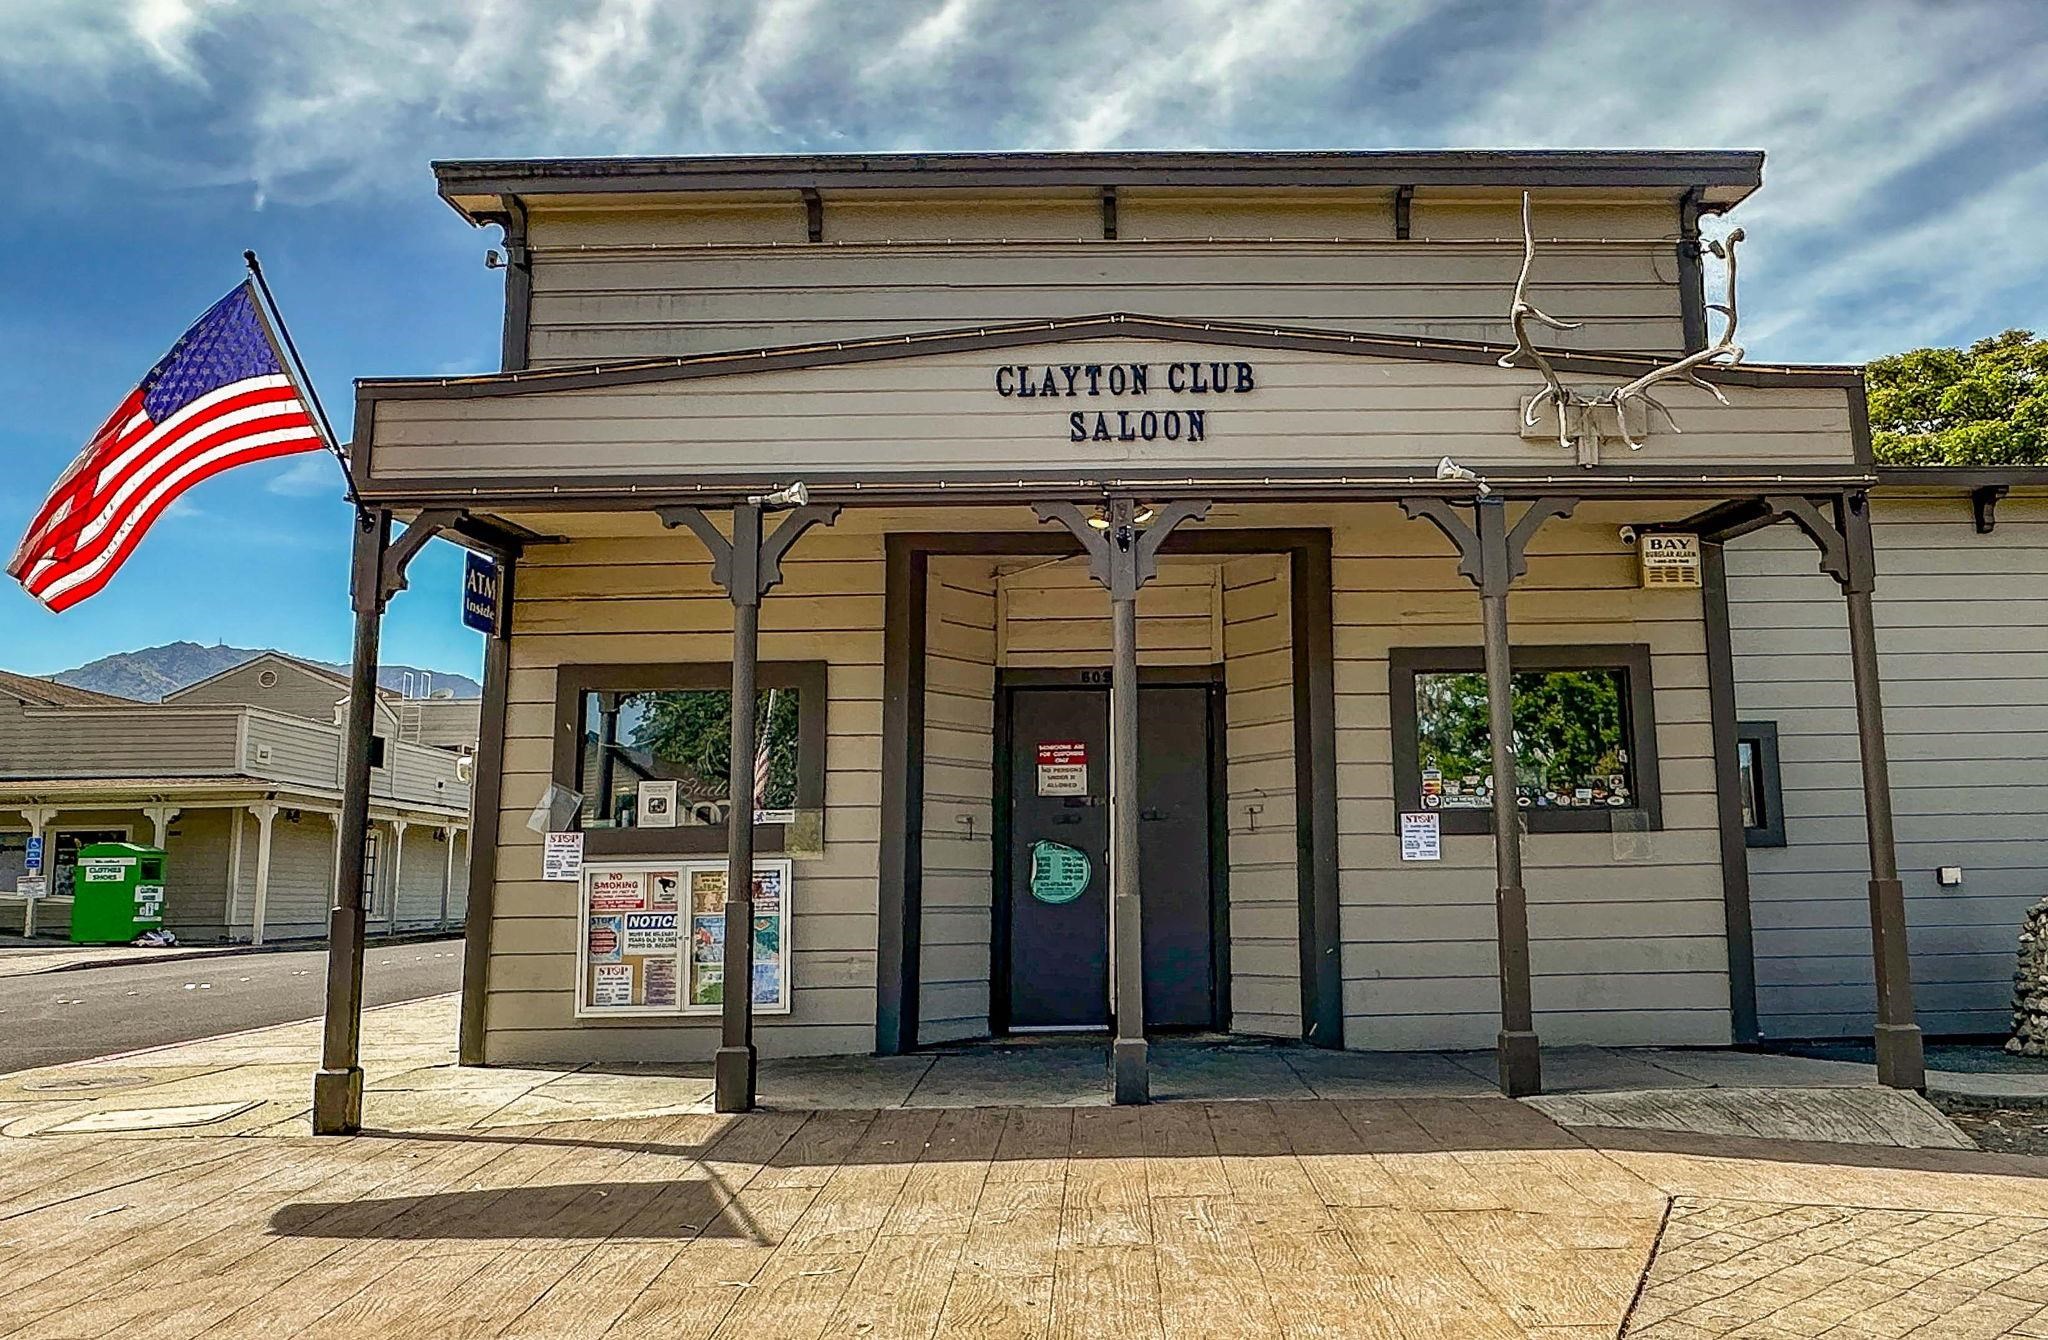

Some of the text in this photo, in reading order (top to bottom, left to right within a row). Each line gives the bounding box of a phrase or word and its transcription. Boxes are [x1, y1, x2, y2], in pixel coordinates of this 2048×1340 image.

[996, 362, 1254, 397] CLAYTON CLUB
[1069, 410, 1205, 442] SALOON
[1651, 539, 1690, 549] BAY
[467, 568, 496, 600] ATM
[466, 598, 494, 619] Inside
[1405, 815, 1434, 823] STOP
[550, 834, 579, 843] STOP
[609, 872, 623, 881] NO
[594, 881, 638, 890] SMOKING
[599, 967, 628, 976] STOP
